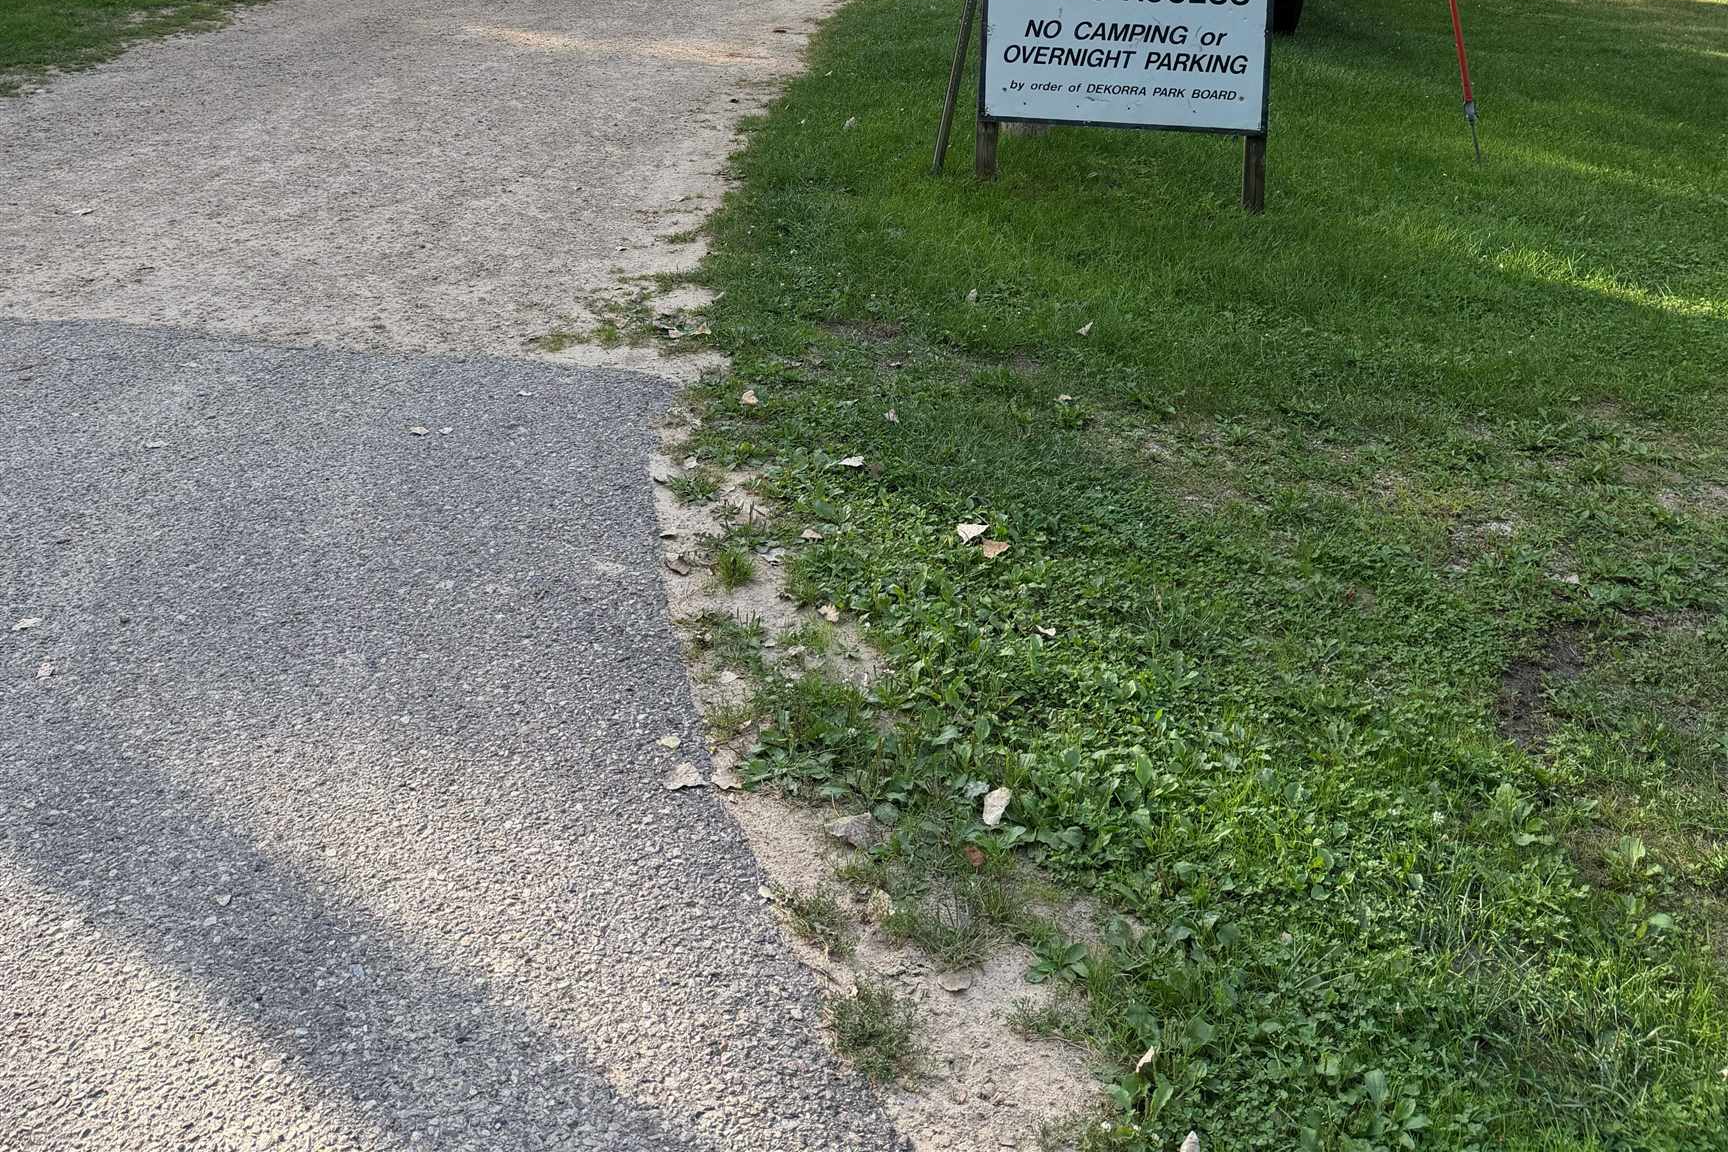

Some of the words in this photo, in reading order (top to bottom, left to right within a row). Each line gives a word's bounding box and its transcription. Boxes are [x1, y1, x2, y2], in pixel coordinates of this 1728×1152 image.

[1024, 19, 1062, 39] NO
[1073, 21, 1188, 45] CAMPING
[1200, 31, 1228, 46] or
[1003, 44, 1137, 69] OVERNIGHT
[1144, 52, 1249, 75] PARKING
[1009, 79, 1025, 91] by
[1030, 82, 1063, 92] order
[1068, 83, 1082, 93] of
[1086, 83, 1147, 97] DEKORRA
[1152, 87, 1187, 98] PARK
